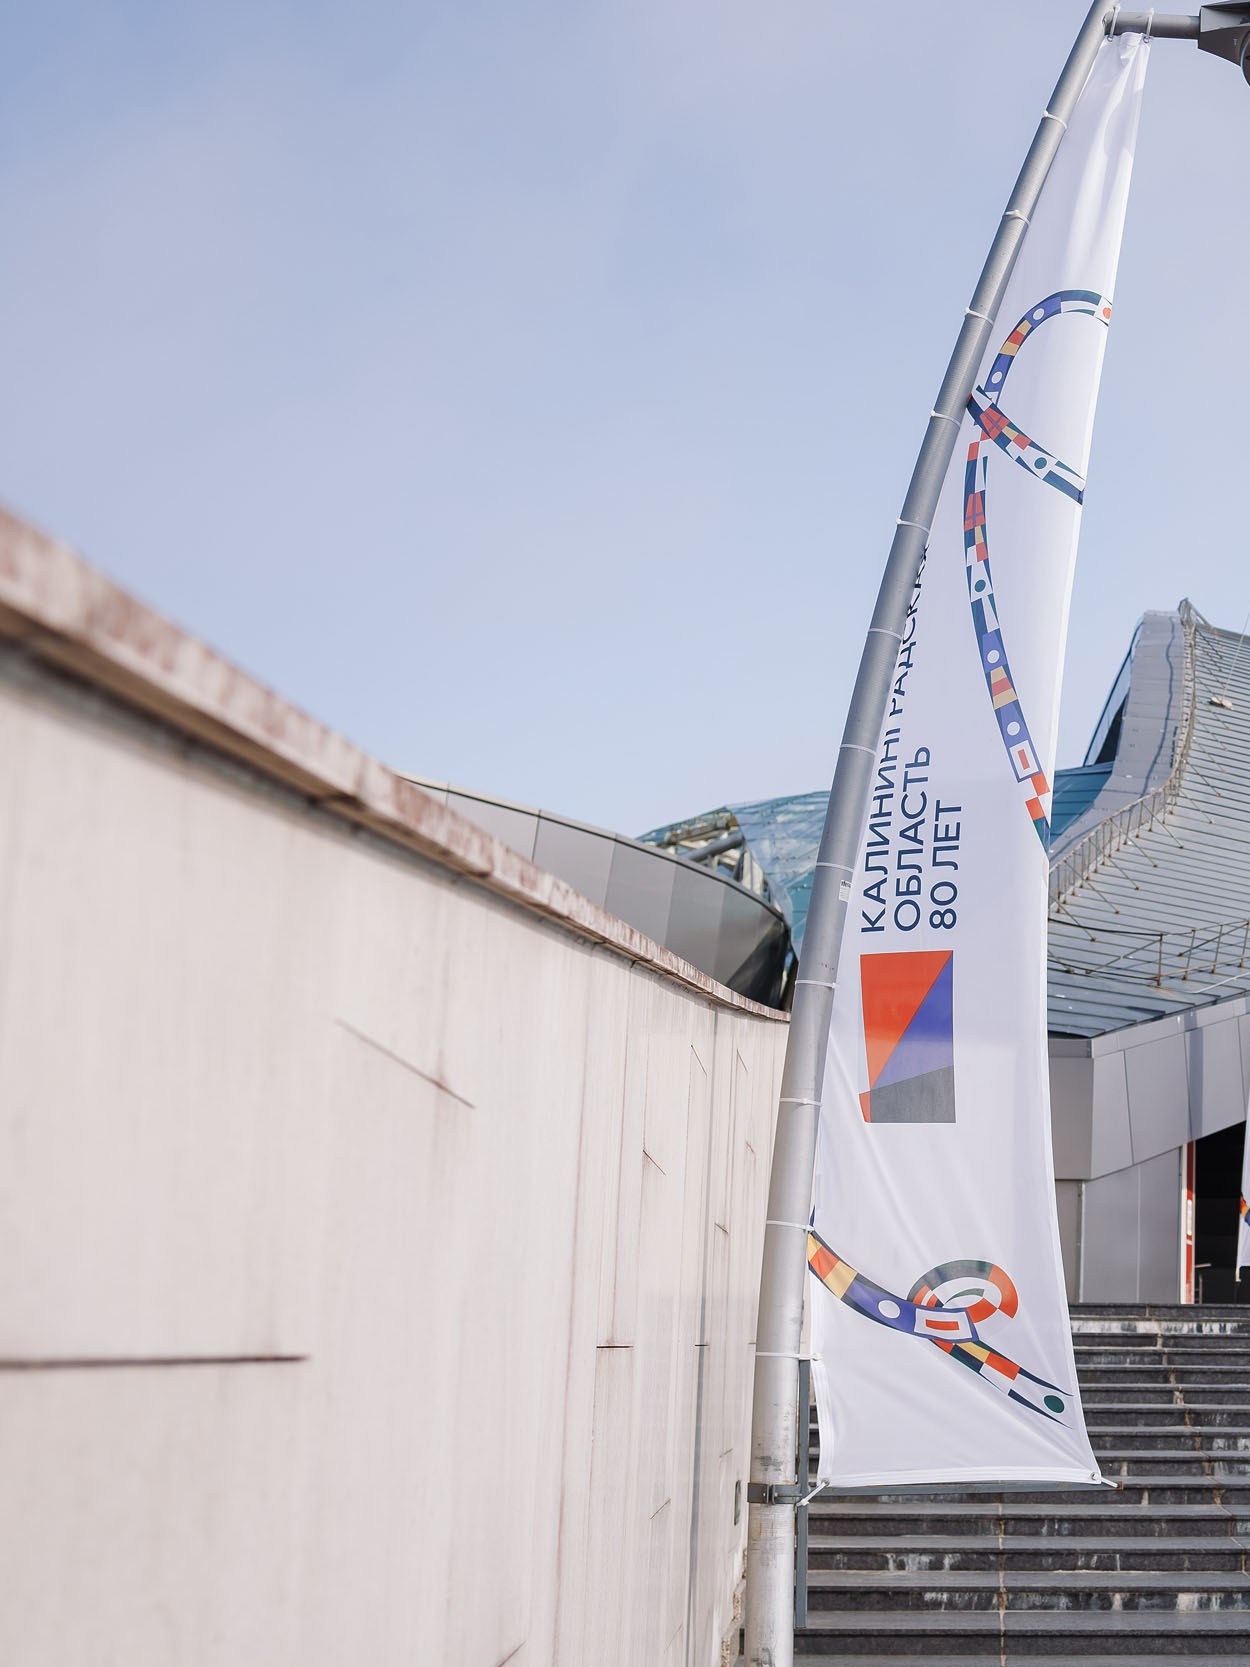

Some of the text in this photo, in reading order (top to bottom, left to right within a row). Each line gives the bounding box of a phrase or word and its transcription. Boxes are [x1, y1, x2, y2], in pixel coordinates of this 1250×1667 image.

[894, 746, 931, 932] ОБЛАСТЬ
[929, 799, 962, 930] 80 ЛЕТ
